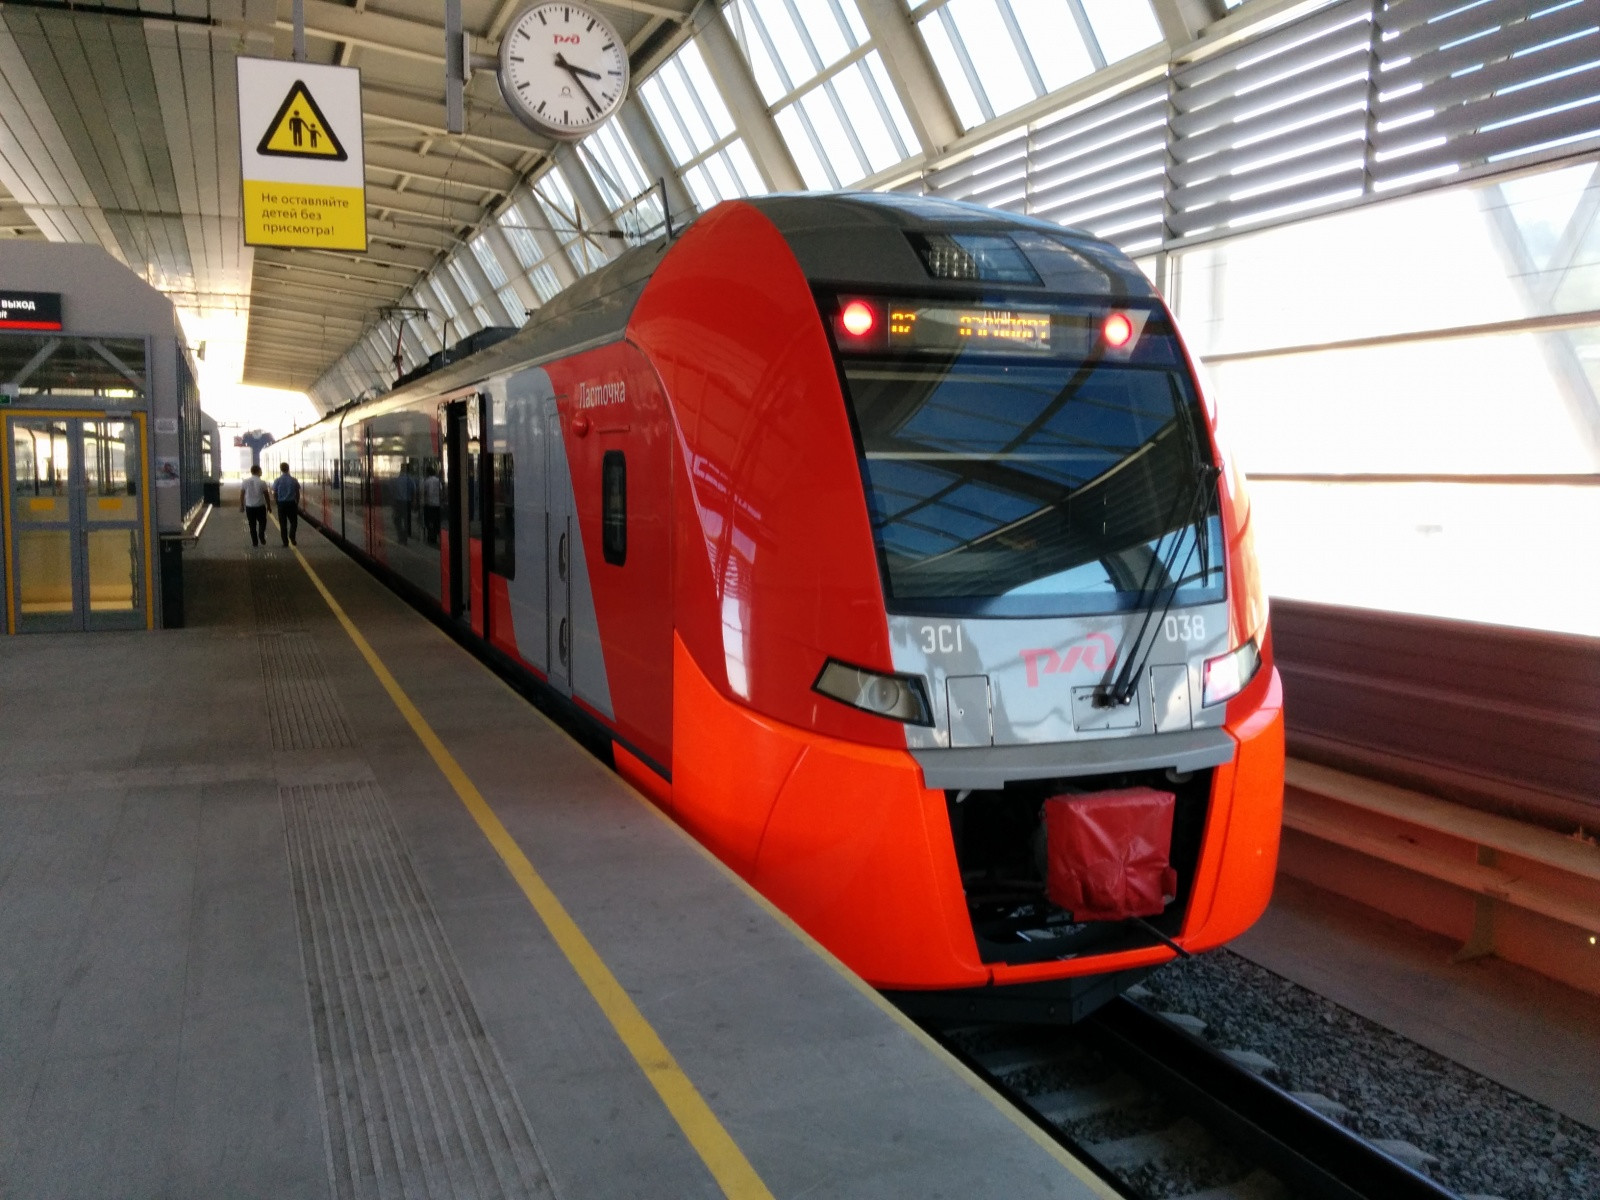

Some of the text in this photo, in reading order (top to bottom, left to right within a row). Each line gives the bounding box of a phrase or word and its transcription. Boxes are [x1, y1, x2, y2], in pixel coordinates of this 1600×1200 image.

[261, 193, 349, 208] Не оставляйте
[261, 208, 322, 220] детей без
[263, 222, 335, 236] присмотра!
[579, 381, 626, 409] Ласточка
[1164, 614, 1206, 642] 038
